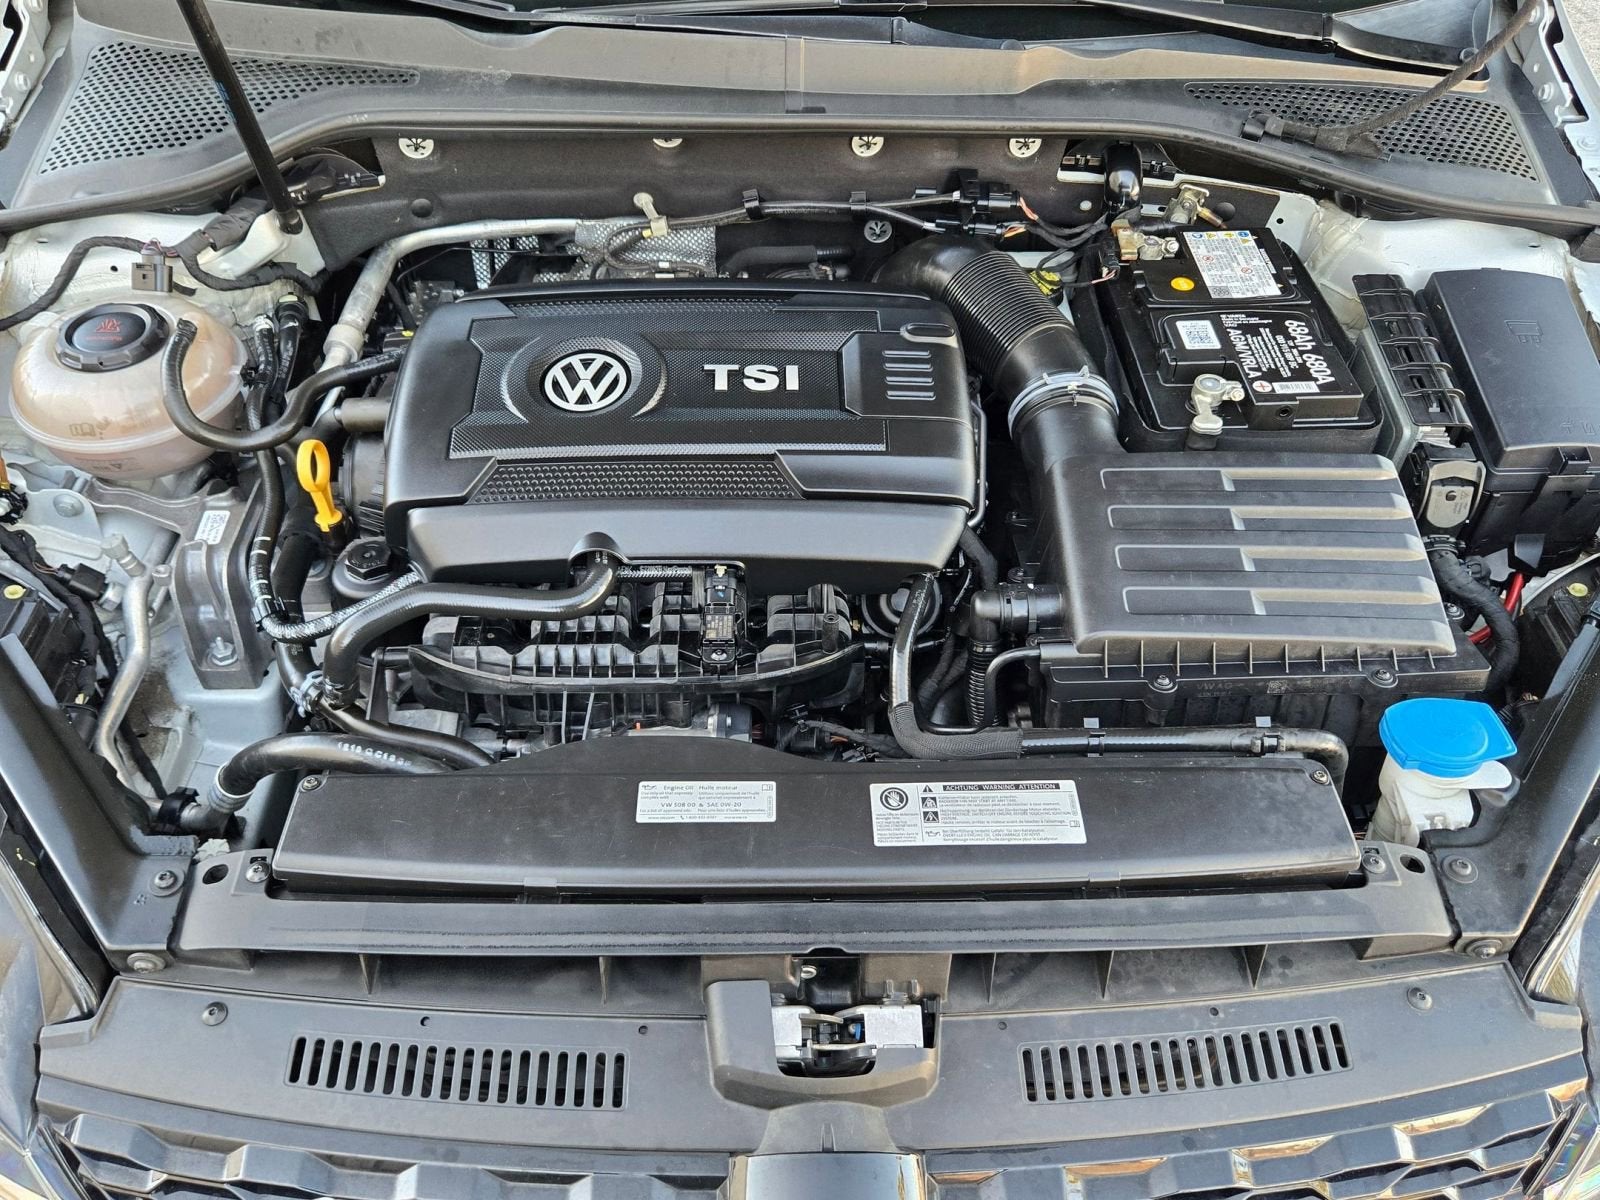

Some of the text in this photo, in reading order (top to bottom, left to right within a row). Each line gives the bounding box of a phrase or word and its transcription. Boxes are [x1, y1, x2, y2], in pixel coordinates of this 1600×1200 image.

[1226, 328, 1262, 378] AGM/VRLA
[1284, 319, 1317, 351] 68Ah
[1302, 353, 1336, 385] 680A
[703, 364, 800, 392] TSI
